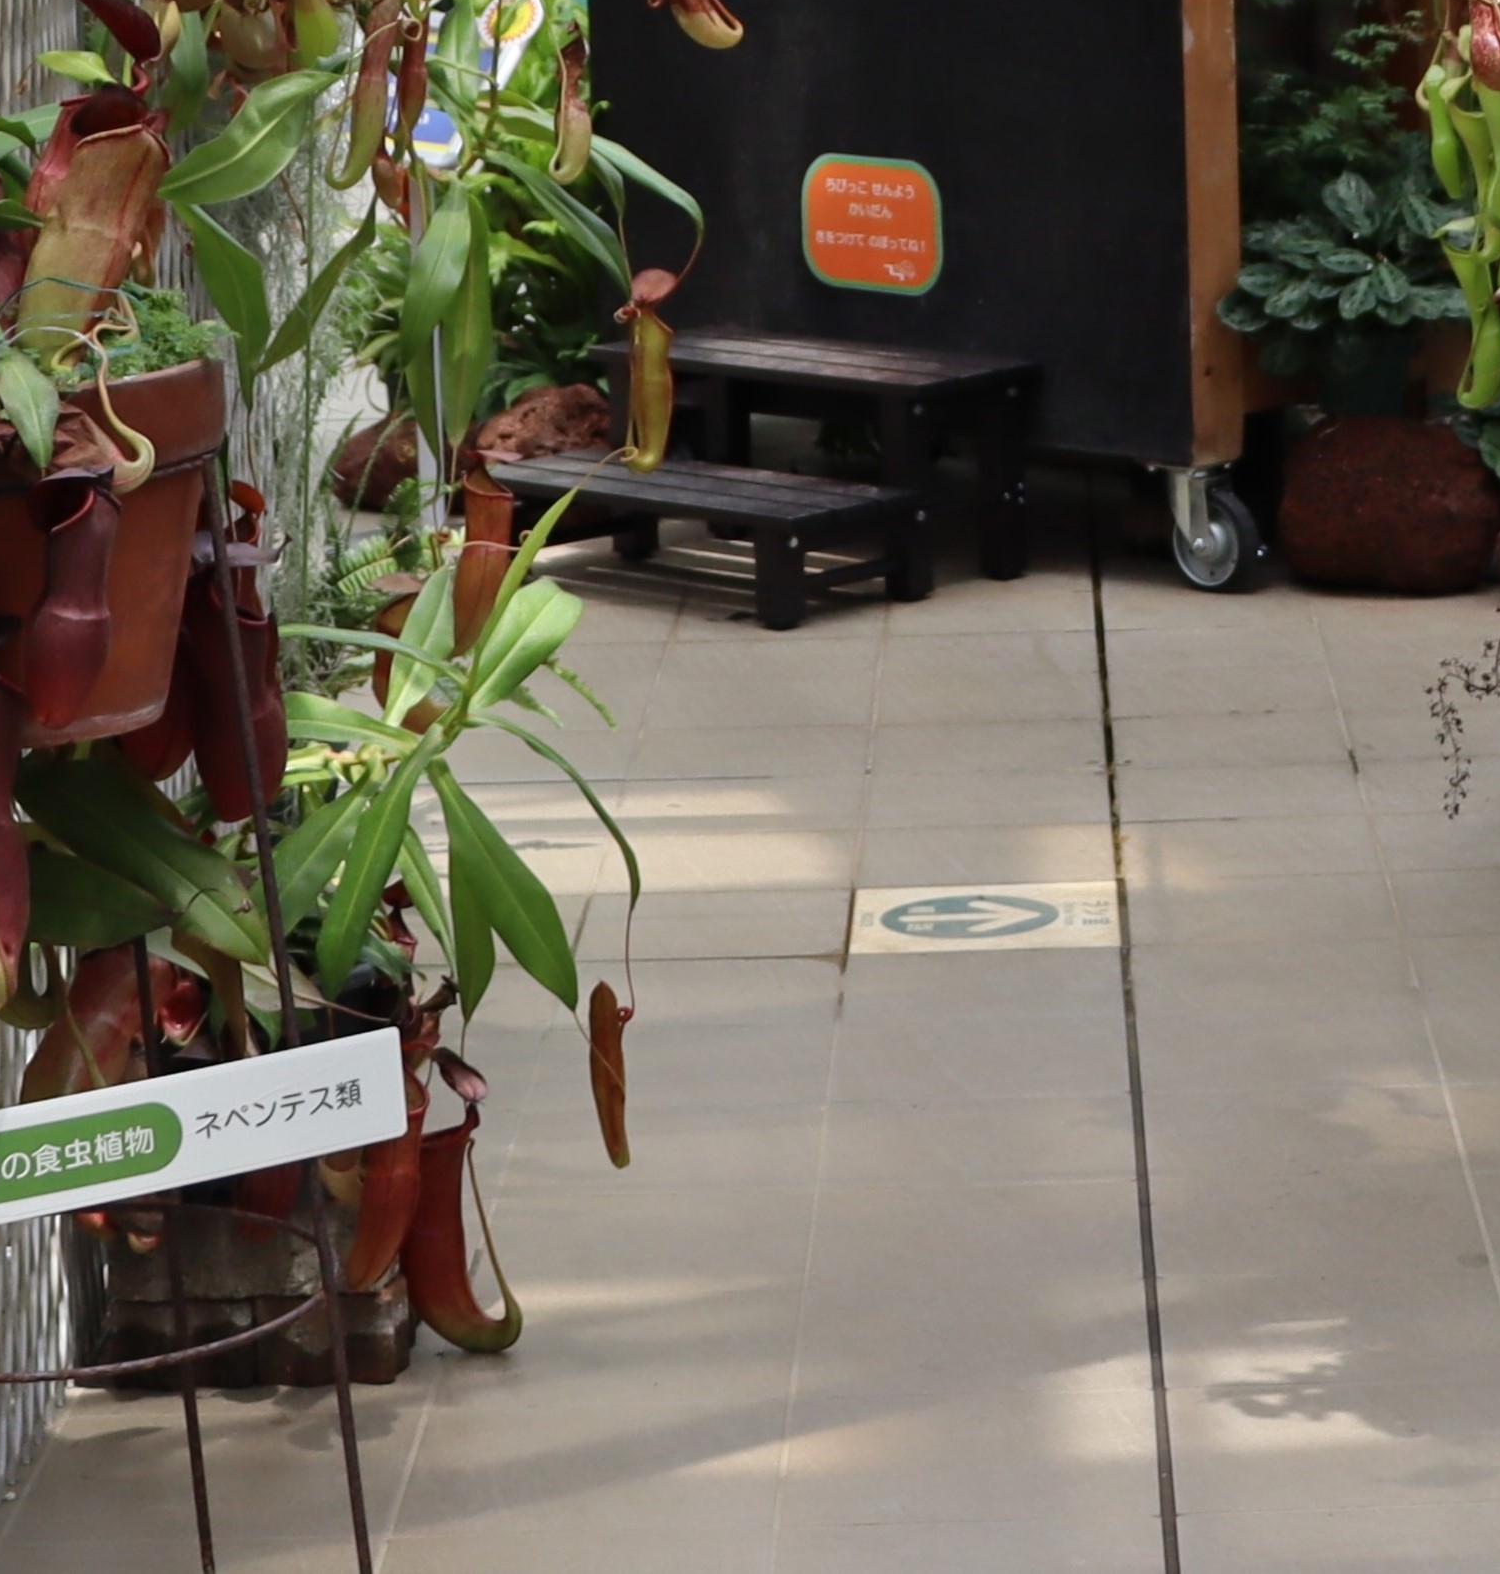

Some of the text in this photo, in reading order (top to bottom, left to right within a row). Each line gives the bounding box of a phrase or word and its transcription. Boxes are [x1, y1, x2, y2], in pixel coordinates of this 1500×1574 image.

[194, 1078, 363, 1139] ネペンテス類
